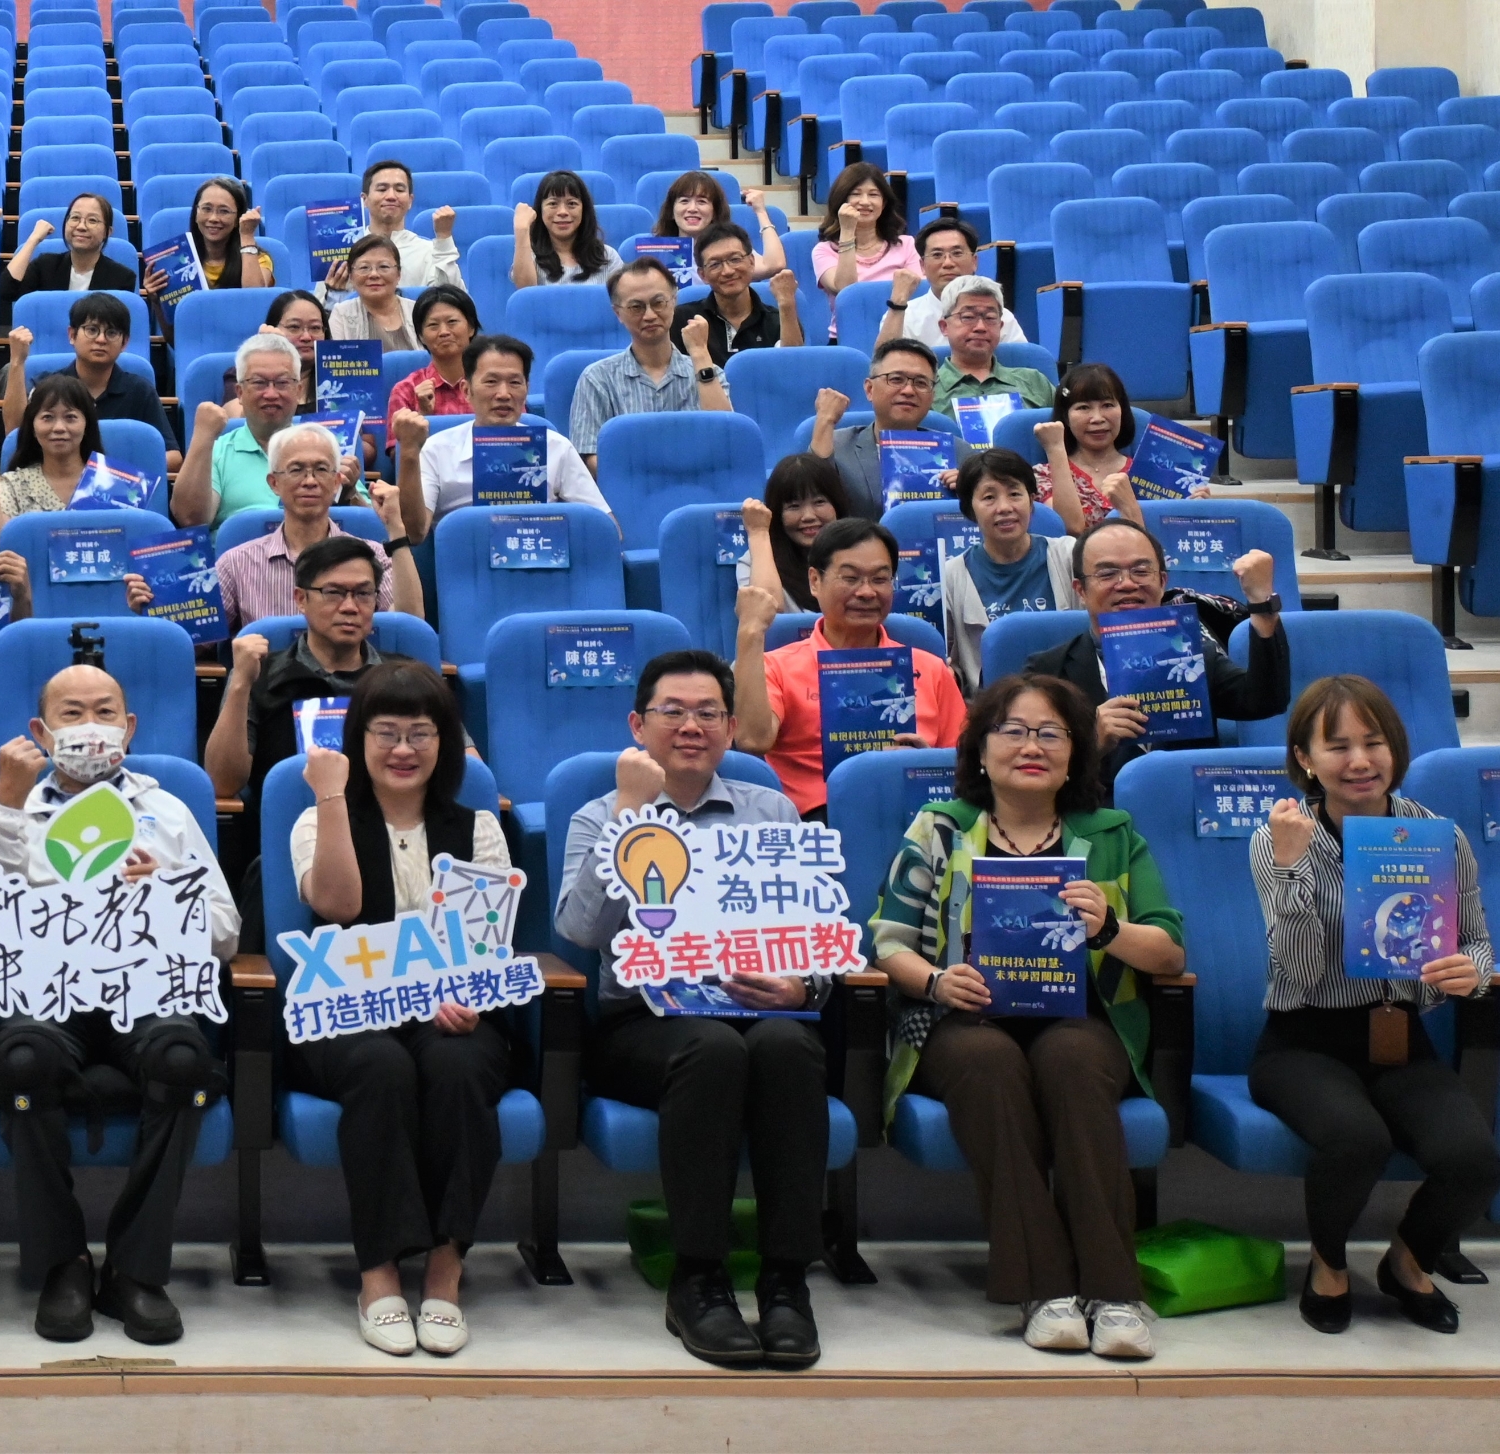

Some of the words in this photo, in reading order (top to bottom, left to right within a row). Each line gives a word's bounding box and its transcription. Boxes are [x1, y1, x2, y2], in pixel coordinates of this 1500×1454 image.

[1177, 538, 1224, 553] 林妙英
[565, 650, 617, 666] 陳俊生
[1216, 795, 1275, 814] 張素貞
[714, 827, 840, 868] 以學生
[717, 874, 843, 915] 為中心
[991, 914, 1028, 929] X+AI
[286, 908, 469, 994] X+AI
[618, 921, 862, 982] 為幸福而教
[978, 954, 1064, 969] 擁抱科技AI智慧-
[995, 970, 1076, 984] 未來學習關鍵力
[1042, 985, 1076, 994] 成果手冊
[289, 963, 541, 1041] 打造新時代教學
